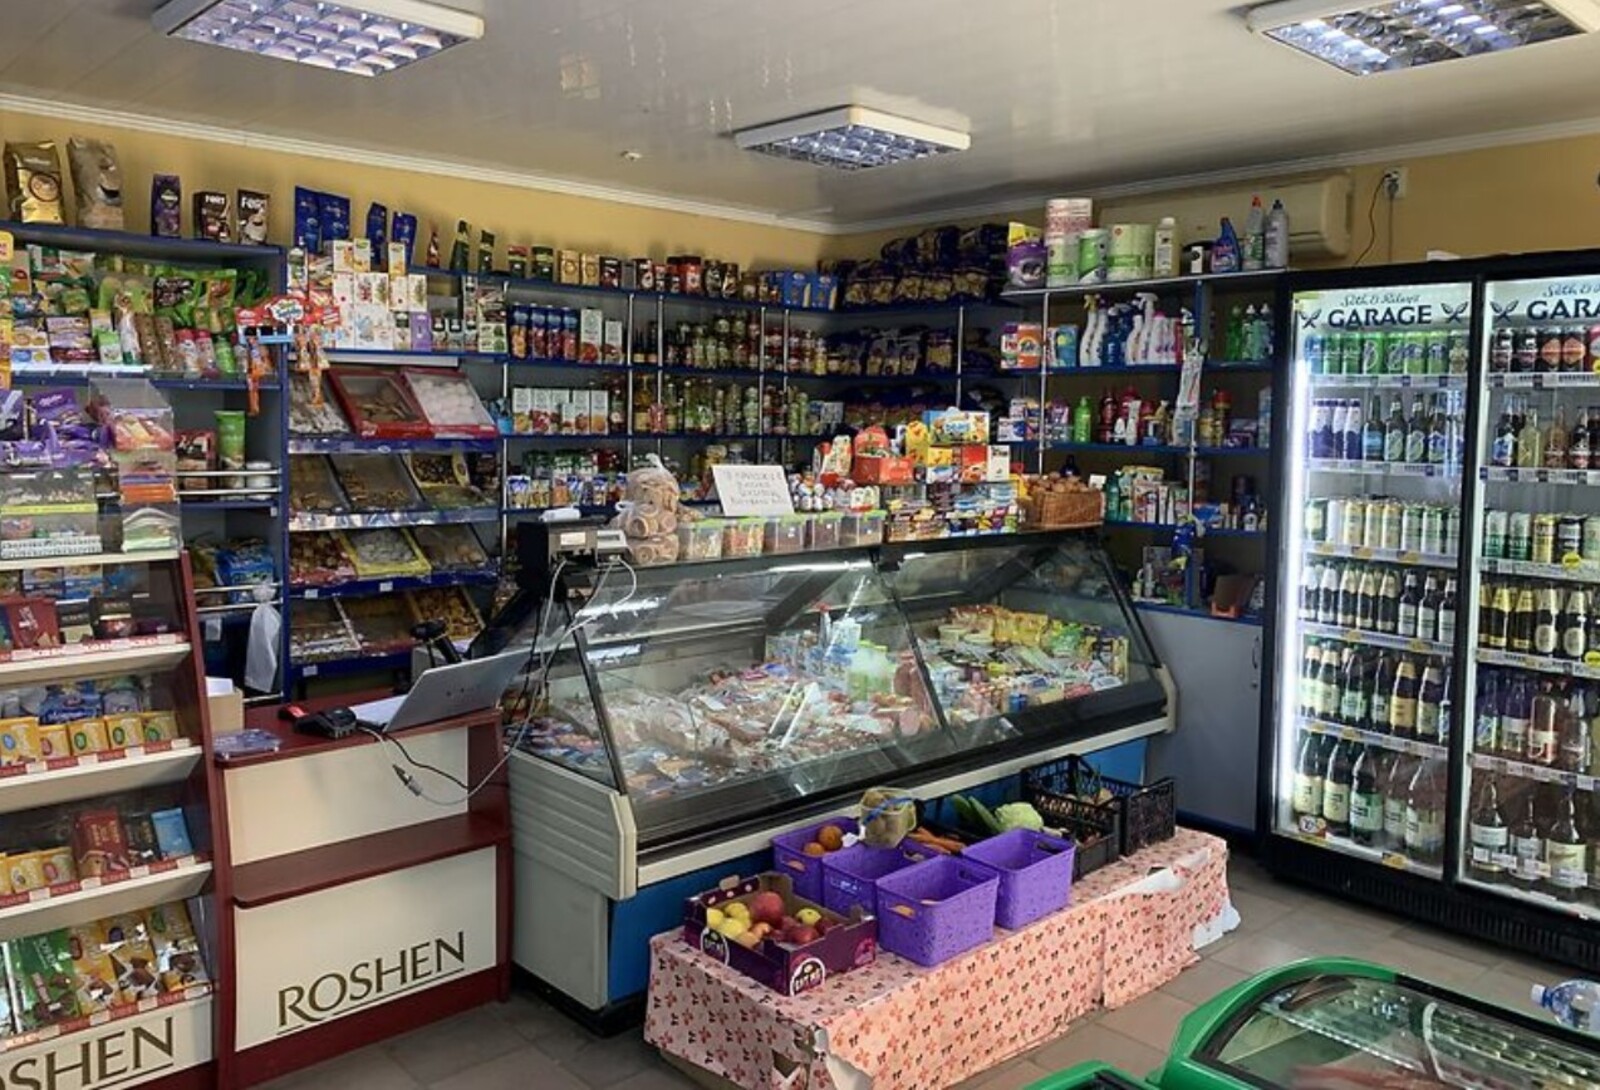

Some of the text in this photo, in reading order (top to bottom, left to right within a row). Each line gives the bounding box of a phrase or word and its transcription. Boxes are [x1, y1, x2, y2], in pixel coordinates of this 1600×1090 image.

[1328, 304, 1432, 327] GARAGE
[1527, 298, 1600, 320] GAR
[277, 930, 465, 1028] ROSHEN
[0, 1016, 174, 1090] SHEN
